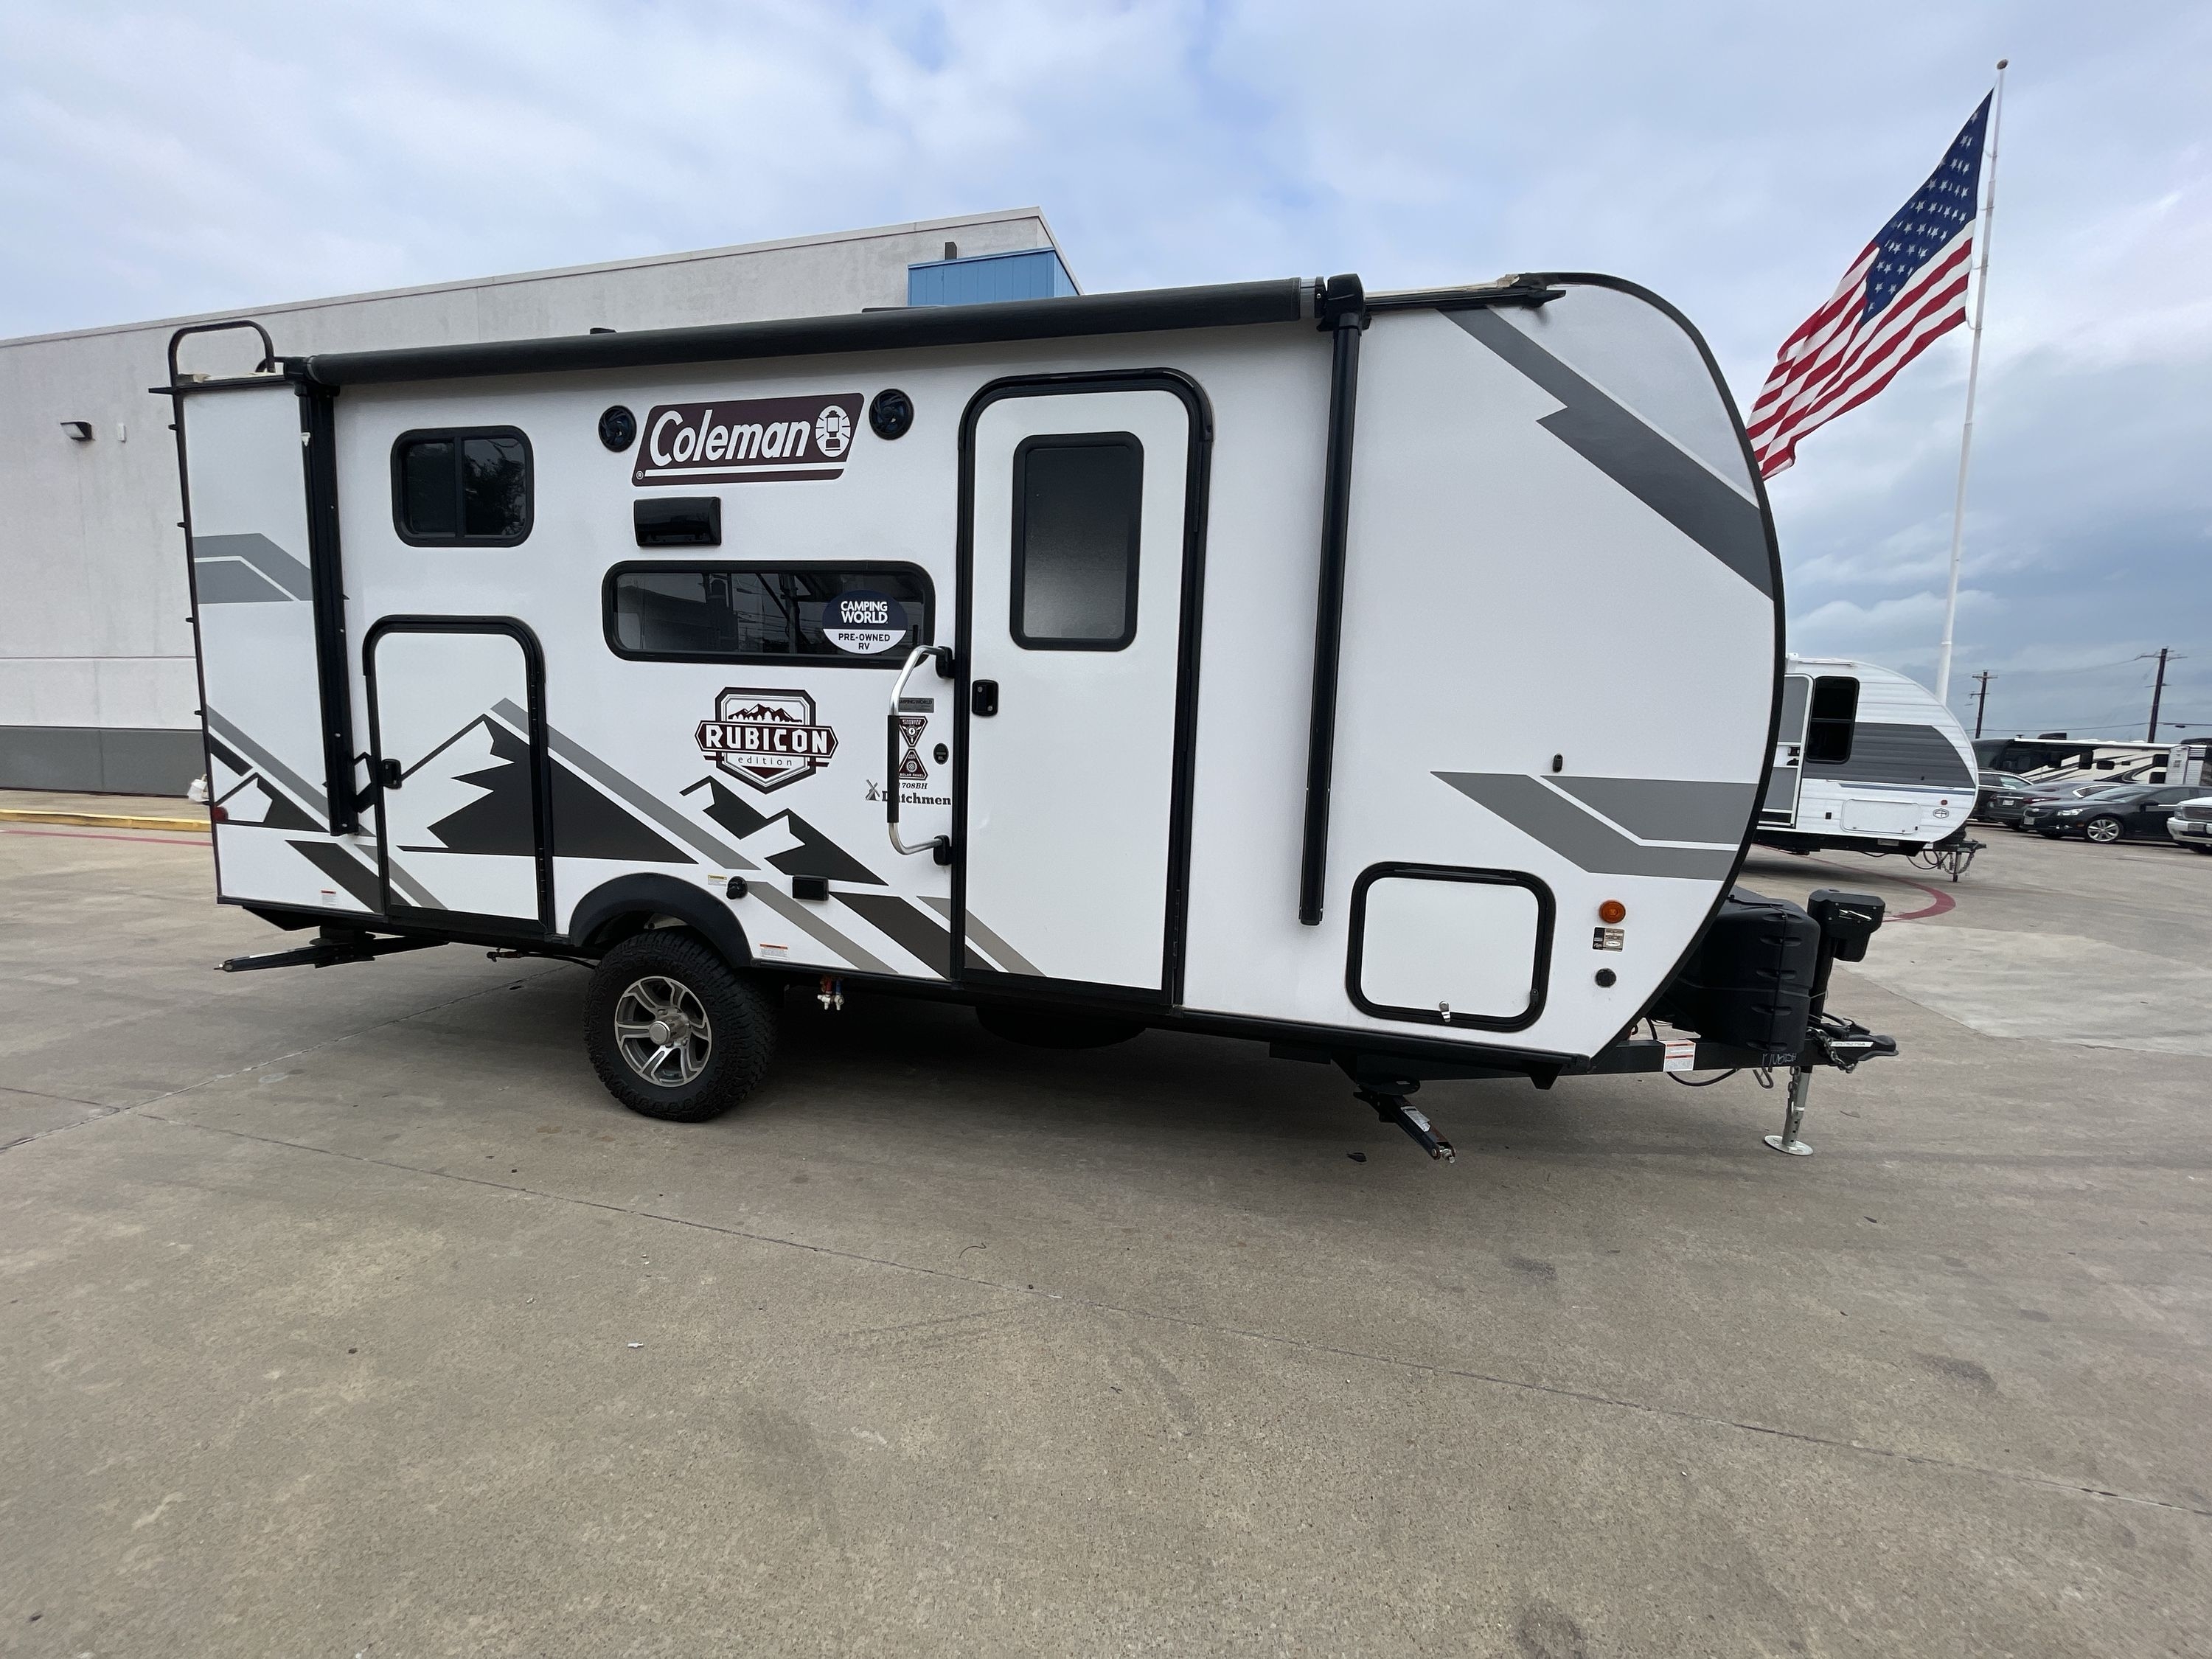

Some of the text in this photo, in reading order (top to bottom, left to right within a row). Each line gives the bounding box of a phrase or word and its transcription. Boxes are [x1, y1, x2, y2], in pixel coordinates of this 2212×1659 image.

[650, 409, 811, 467] Coleman
[841, 601, 888, 611] CAMPING
[841, 611, 888, 624] WORLD
[838, 633, 890, 641] PRE-OWNED
[706, 725, 827, 754] RUBICON
[738, 756, 793, 766] edition
[881, 790, 952, 805] Dtchmen
